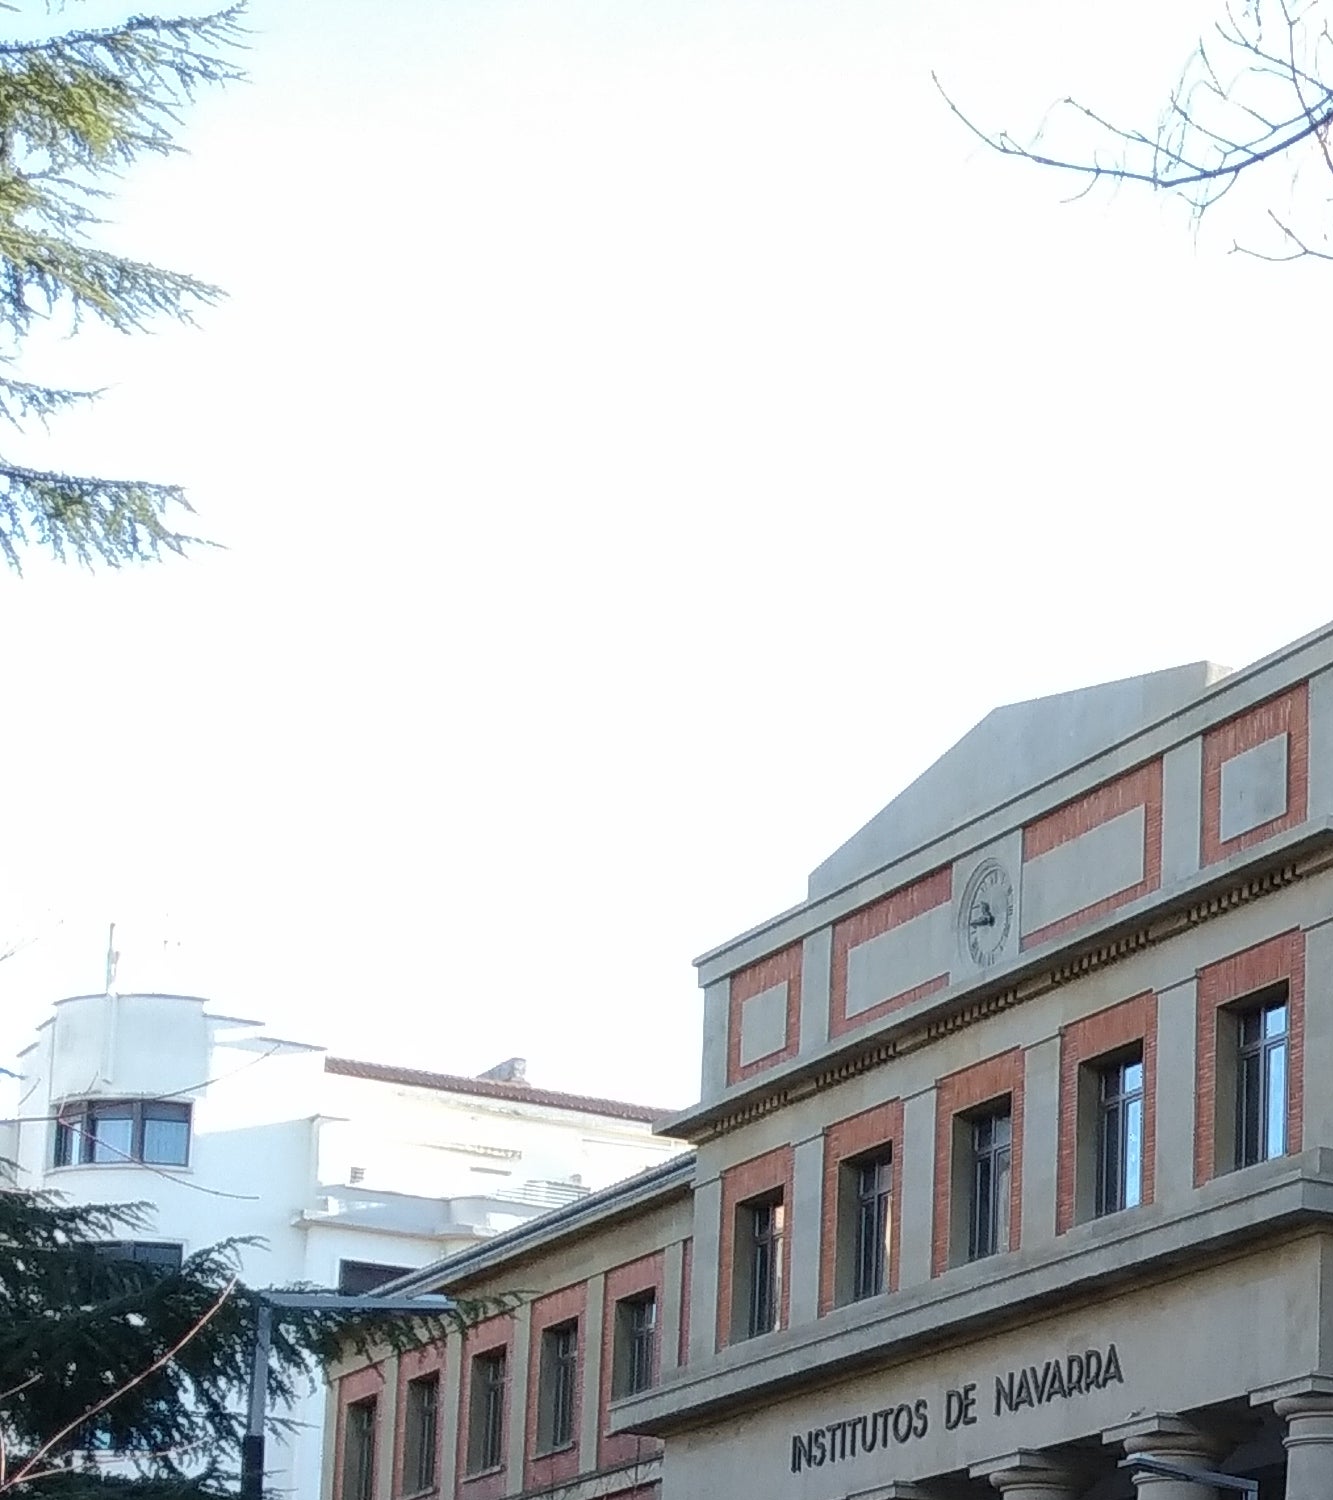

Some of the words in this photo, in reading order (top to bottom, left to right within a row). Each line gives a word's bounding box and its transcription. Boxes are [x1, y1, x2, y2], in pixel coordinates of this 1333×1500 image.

[791, 1399, 929, 1474] INSTITUTOS
[945, 1382, 978, 1431] DE
[994, 1343, 1125, 1417] NAVARRA
